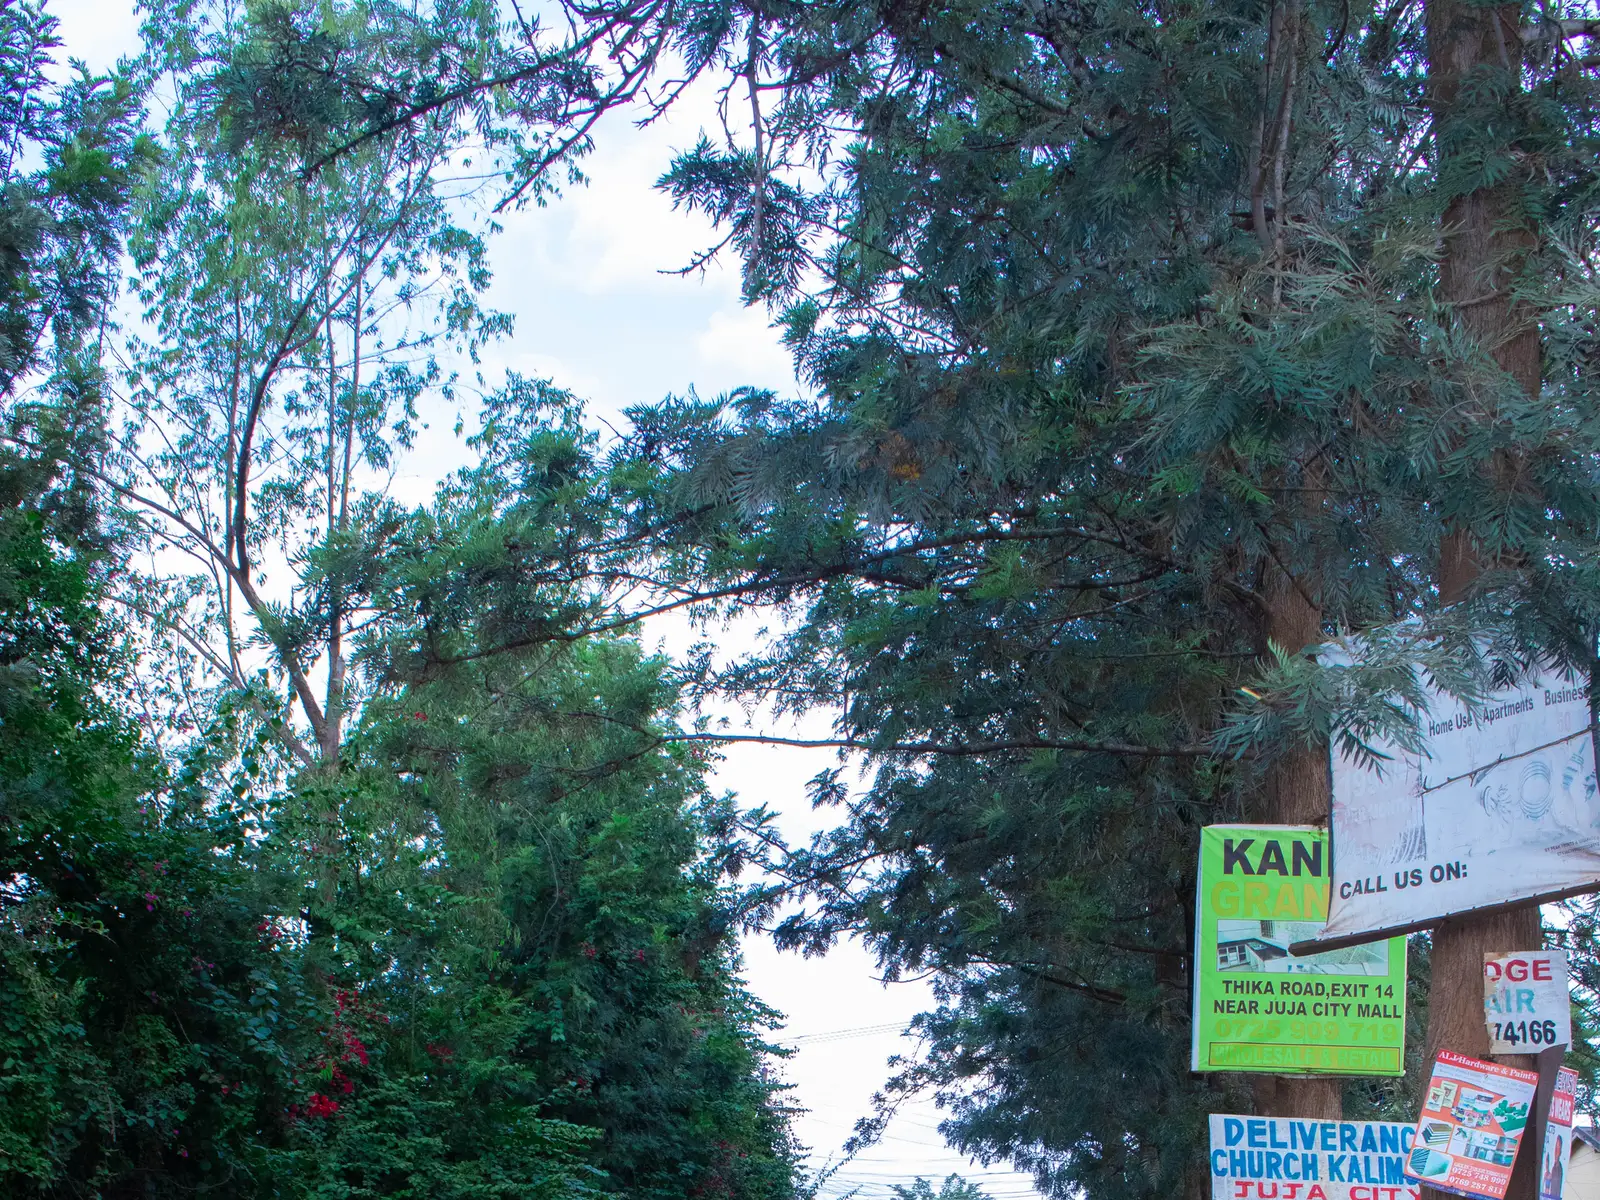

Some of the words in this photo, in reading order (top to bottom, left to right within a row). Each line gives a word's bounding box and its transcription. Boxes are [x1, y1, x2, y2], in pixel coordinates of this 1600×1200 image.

[1429, 718, 1453, 737] Home
[1455, 711, 1472, 730] Use
[1483, 697, 1534, 725] Apartments
[1223, 839, 1331, 877] KAN
[1339, 875, 1388, 900] CALL
[1394, 868, 1424, 889] US
[1429, 861, 1468, 884] ON:
[1222, 980, 1274, 996] THIKA
[1375, 984, 1394, 998] 14
[1213, 999, 1260, 1015] NEAR
[1264, 1001, 1308, 1016] JUJA
[1312, 1002, 1352, 1017] CITY
[1357, 1003, 1402, 1019] MALL
[1215, 1019, 1281, 1039] 0725
[1290, 1021, 1340, 1041] 909
[1348, 1022, 1398, 1043] 719
[1212, 1046, 1316, 1067] WHOLESALE
[1337, 1050, 1395, 1068] RETAIL
[1223, 1117, 1416, 1155] DELIVERANC
[1211, 1148, 1319, 1181] CHURCH
[1327, 1154, 1418, 1186] KALIM
[1234, 1180, 1327, 1200] JUJA
